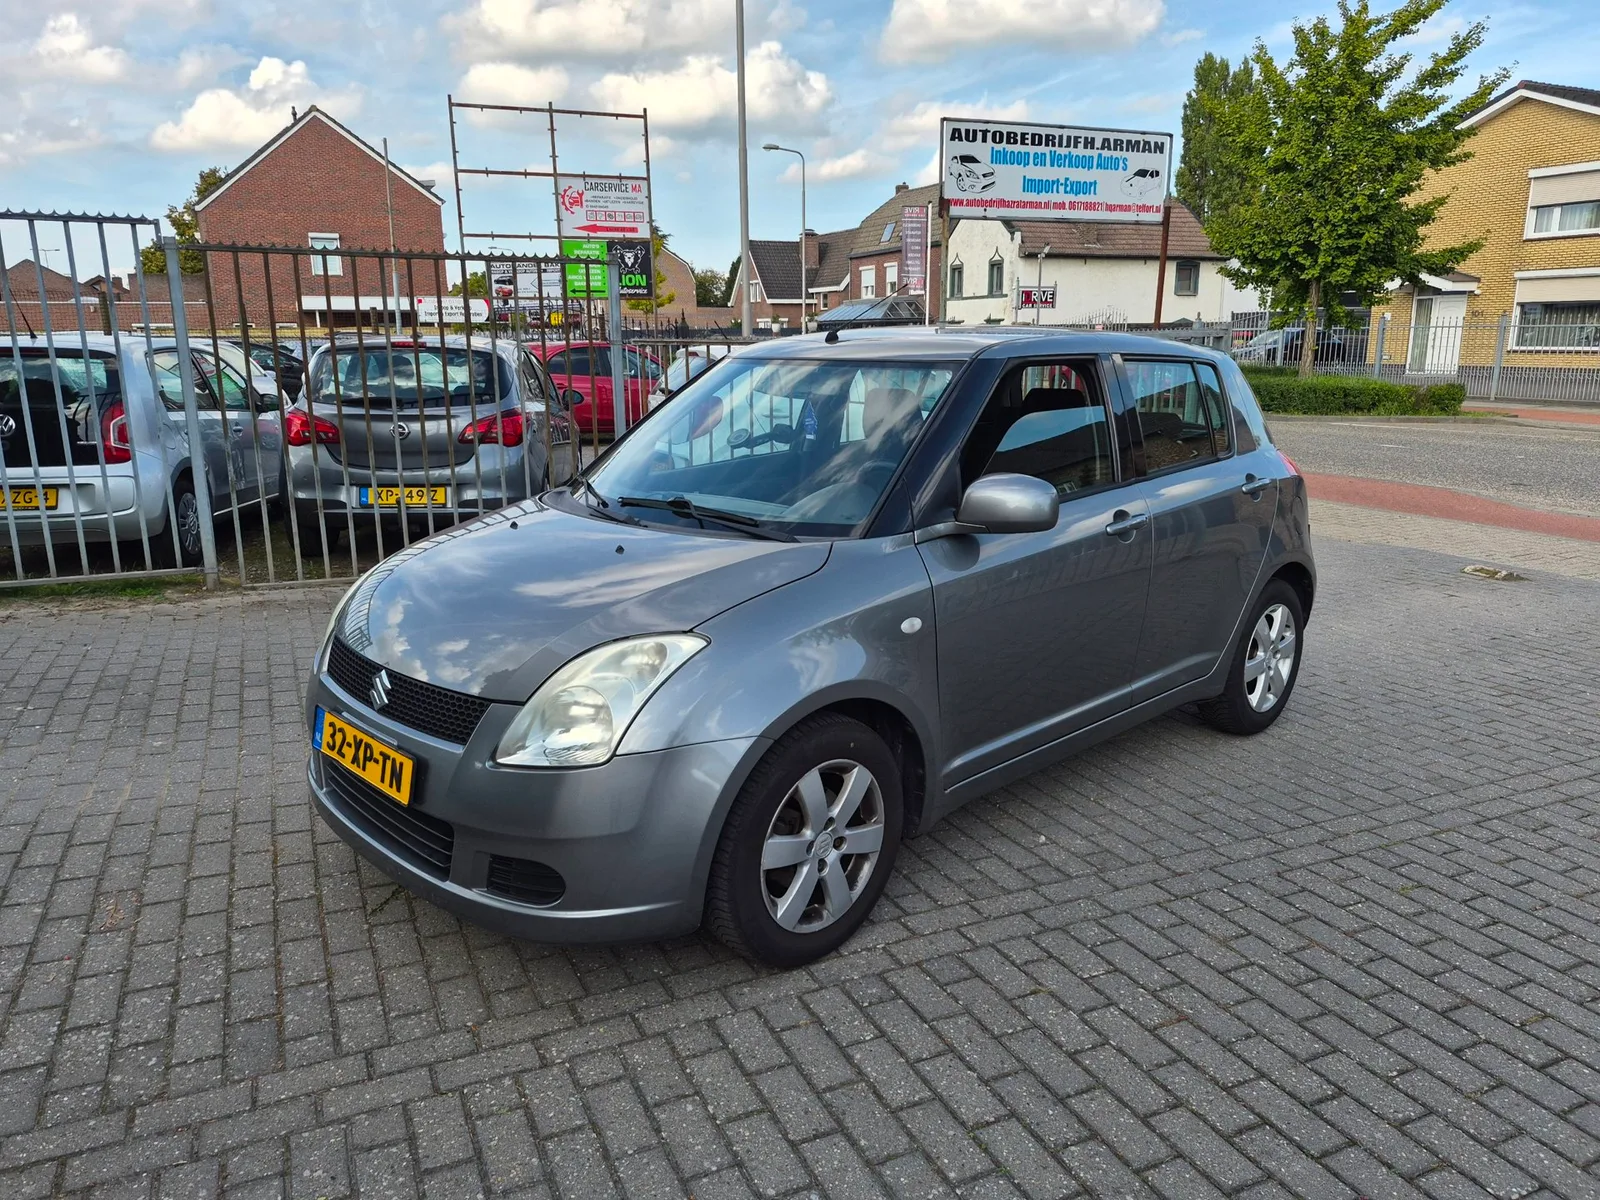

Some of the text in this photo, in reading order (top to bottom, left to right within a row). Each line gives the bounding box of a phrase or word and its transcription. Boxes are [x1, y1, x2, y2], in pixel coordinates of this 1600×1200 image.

[990, 146, 1128, 171] Inkoop en Verkoop Auto's
[584, 181, 642, 193] CARSERVICE MA
[1022, 175, 1098, 196] Import-Export
[619, 274, 647, 287] ION
[326, 721, 404, 793] 32-XP-TN
